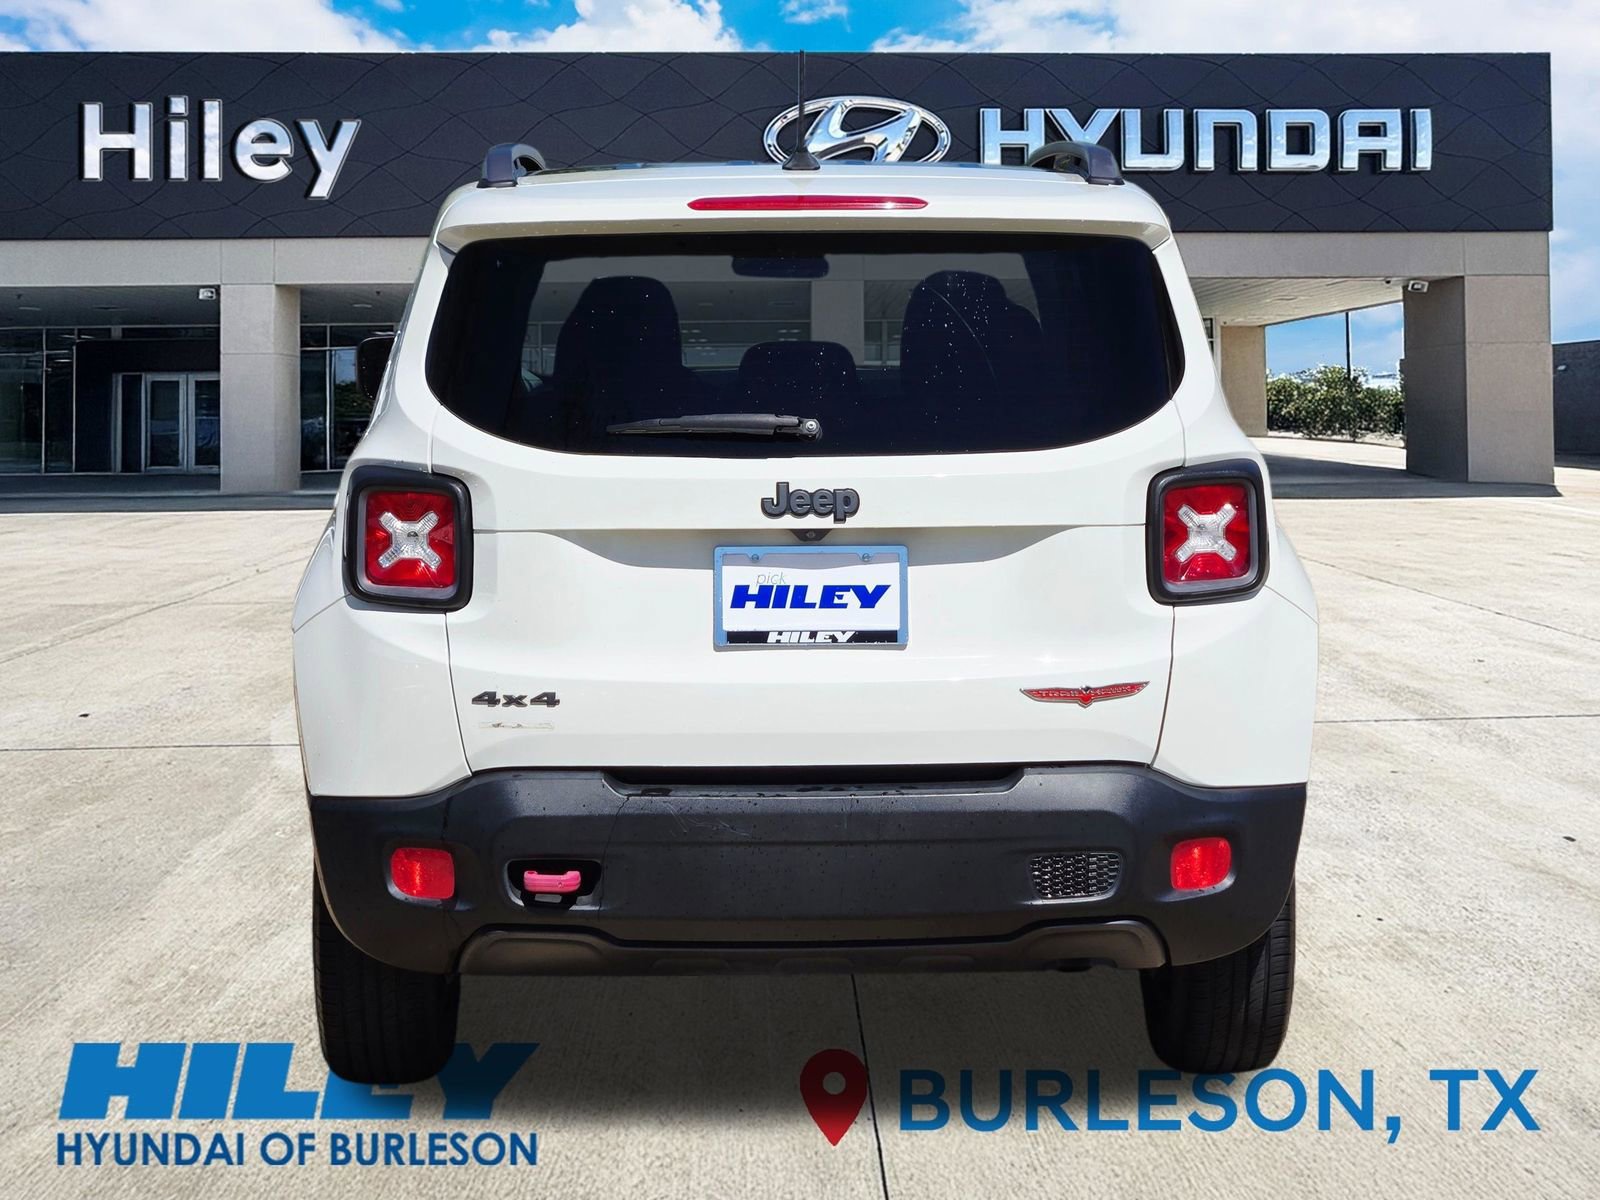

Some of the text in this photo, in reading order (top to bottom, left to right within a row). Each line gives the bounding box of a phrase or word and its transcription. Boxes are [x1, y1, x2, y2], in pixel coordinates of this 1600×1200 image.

[80, 95, 361, 200] Hiley
[979, 107, 1433, 172] HYUNDAI
[761, 481, 860, 524] Jeep
[756, 571, 787, 587] pick
[730, 584, 891, 609] HILEY
[766, 631, 856, 643] HILEY
[471, 690, 560, 708] 4x4
